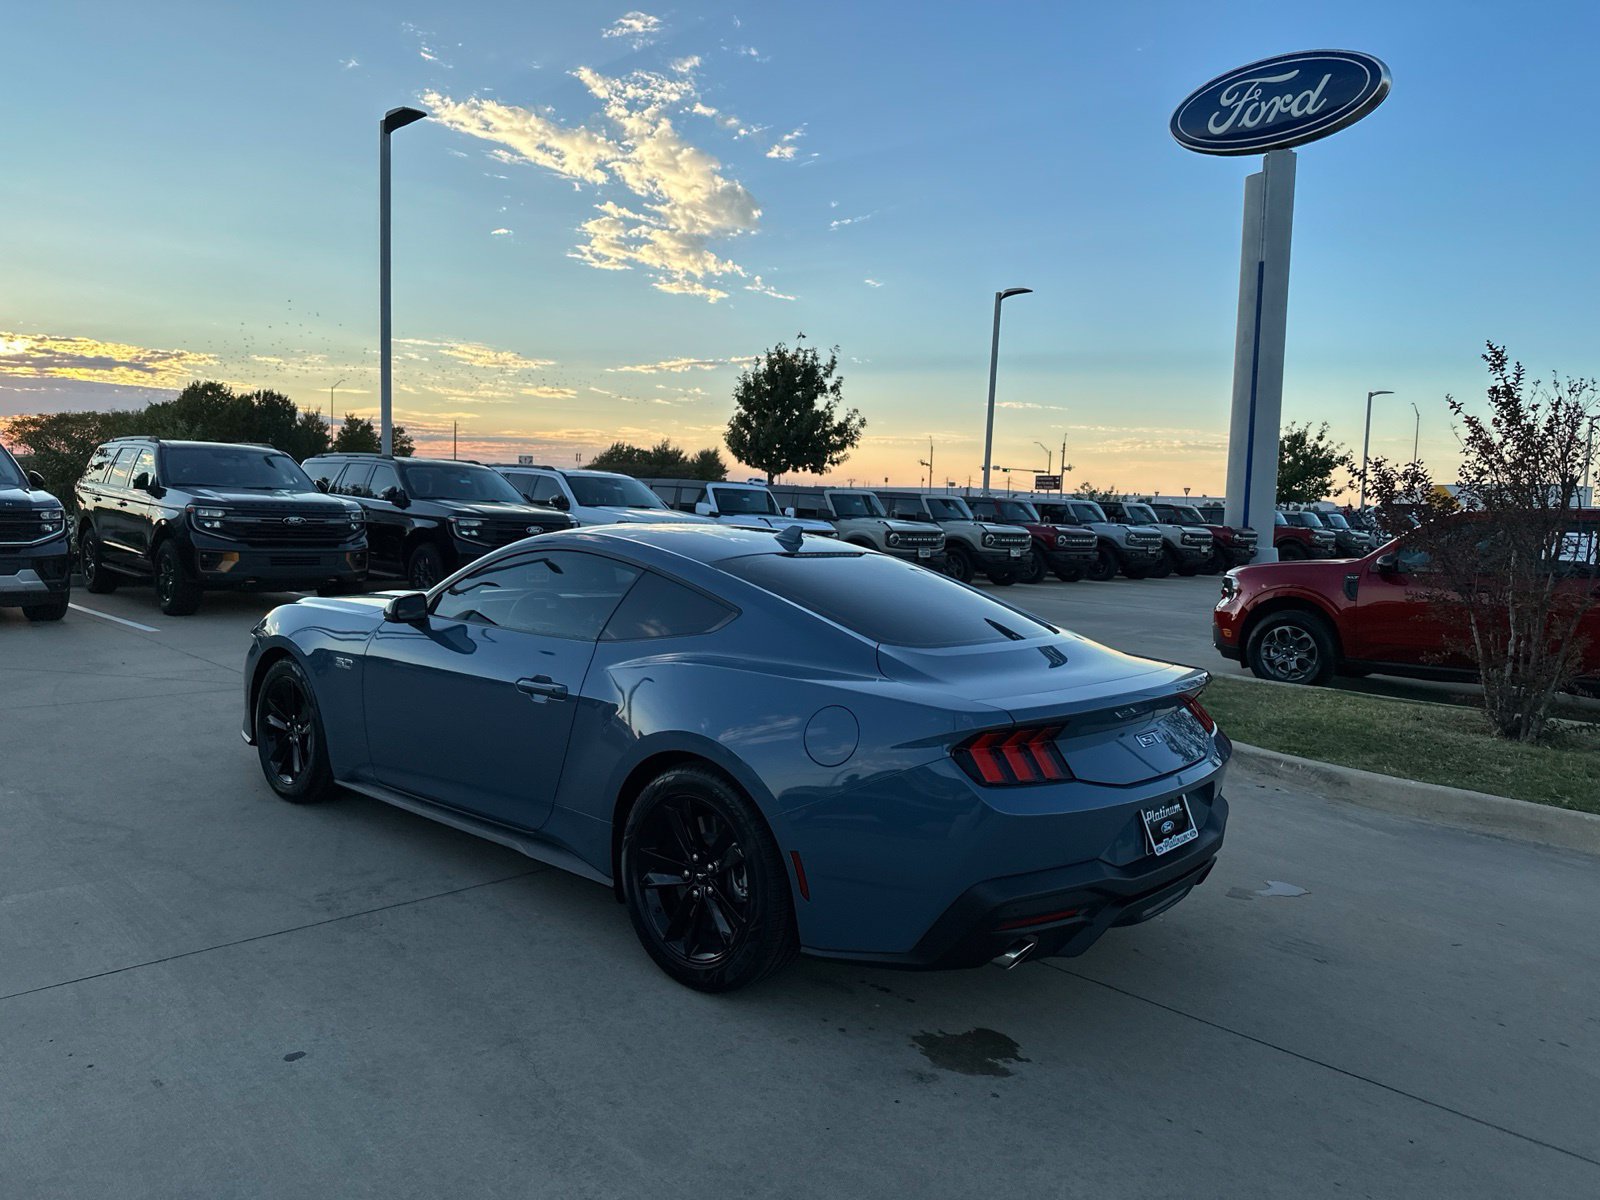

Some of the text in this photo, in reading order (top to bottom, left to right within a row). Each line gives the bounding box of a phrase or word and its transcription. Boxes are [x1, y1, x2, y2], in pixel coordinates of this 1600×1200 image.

[1208, 70, 1331, 134] Ford
[1135, 730, 1162, 748] GT
[1146, 803, 1183, 824] Platinum
